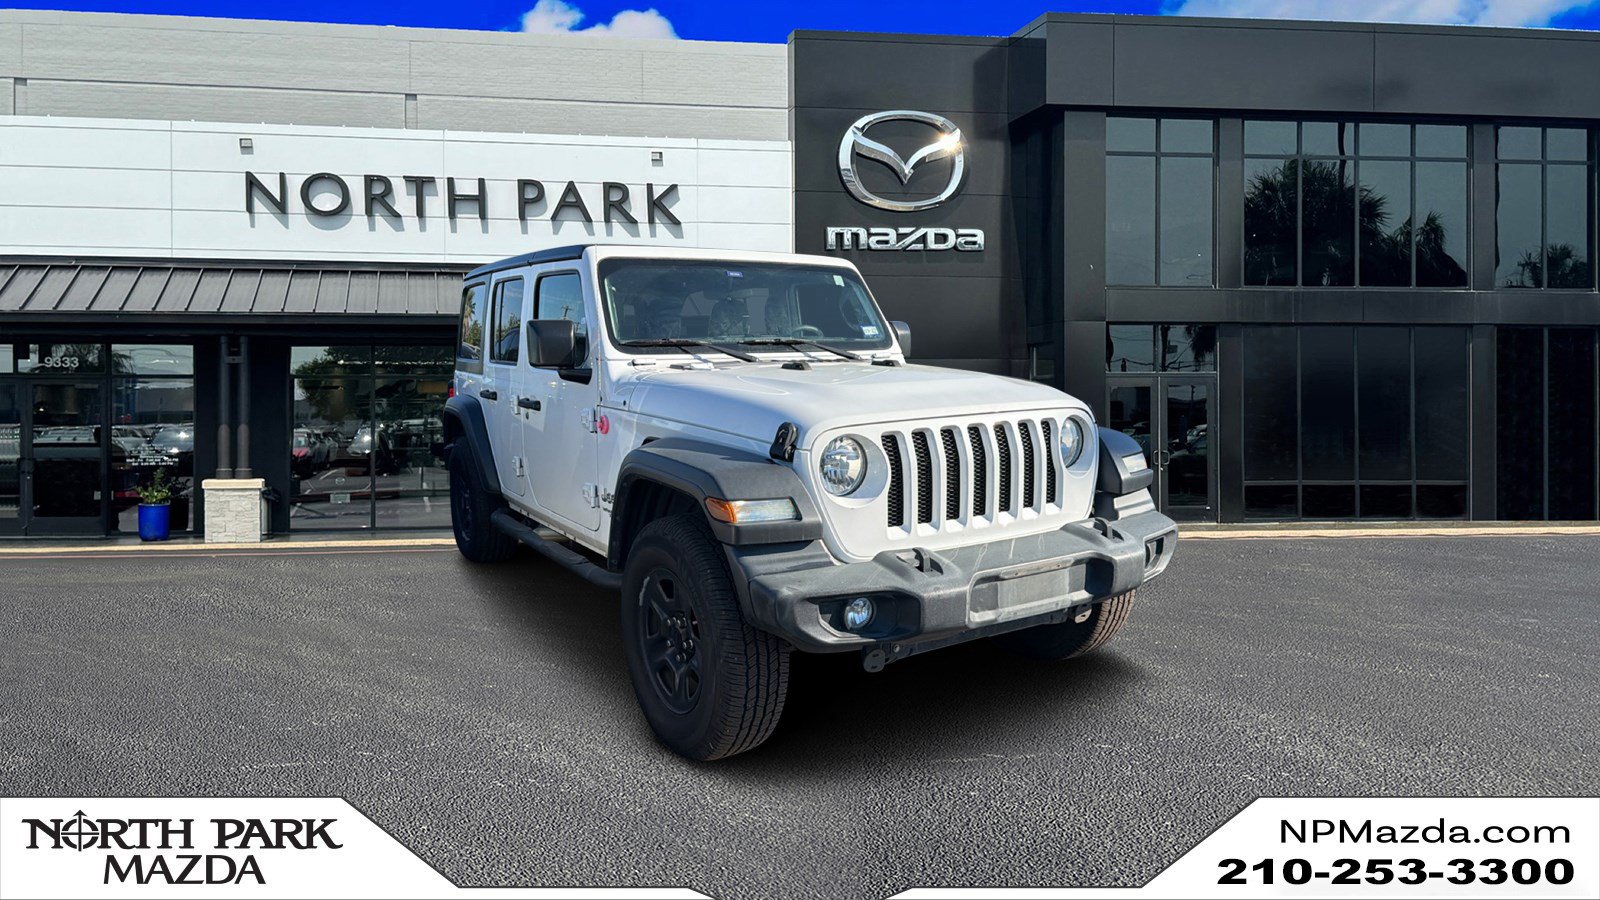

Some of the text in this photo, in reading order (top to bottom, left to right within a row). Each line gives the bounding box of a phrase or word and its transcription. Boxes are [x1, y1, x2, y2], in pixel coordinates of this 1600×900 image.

[245, 171, 682, 226] NORTH PARK
[44, 356, 79, 368] 9333
